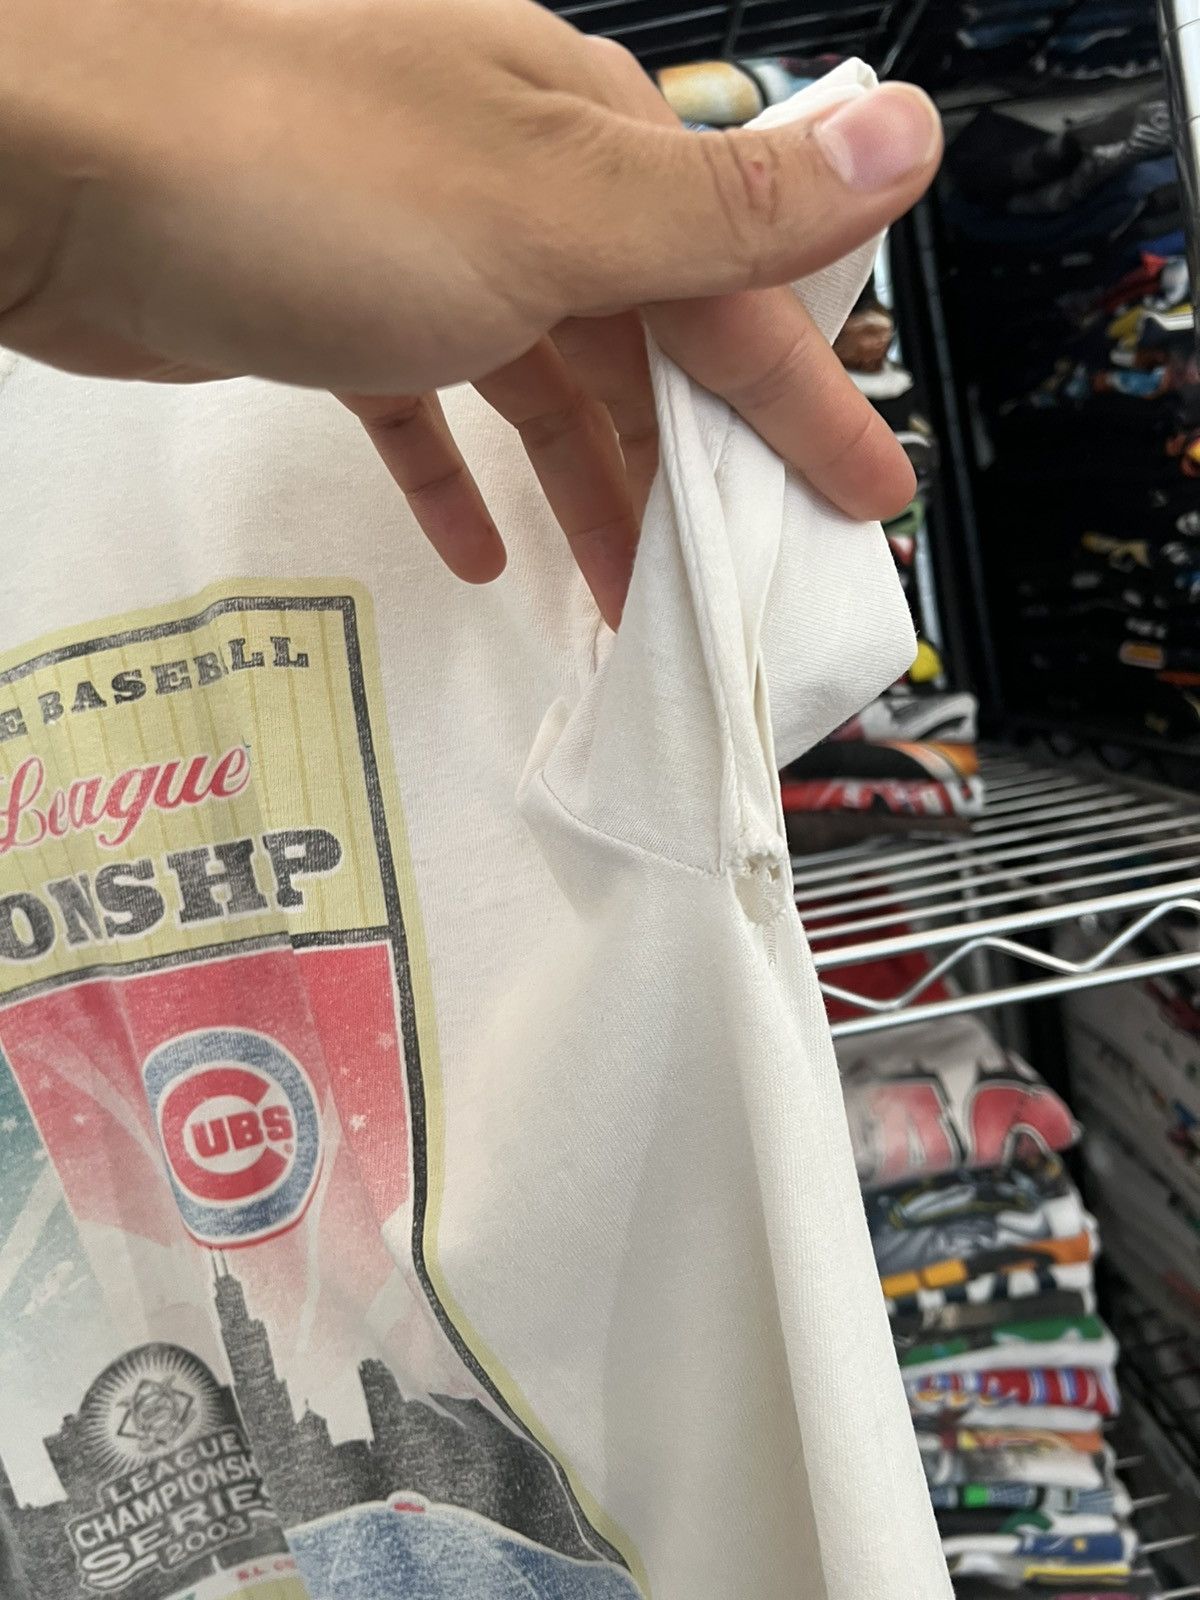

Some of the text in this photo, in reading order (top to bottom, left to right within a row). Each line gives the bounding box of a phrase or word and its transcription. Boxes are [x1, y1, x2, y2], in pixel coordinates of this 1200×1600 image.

[38, 636, 310, 725] BASEBLL
[0, 746, 252, 855] League
[0, 828, 342, 960] ONSHP
[74, 1453, 262, 1548] CHAMPIONSH
[108, 1431, 242, 1503] LEAGUE
[82, 1483, 272, 1584] SERIE
[165, 1514, 248, 1565] 2003
